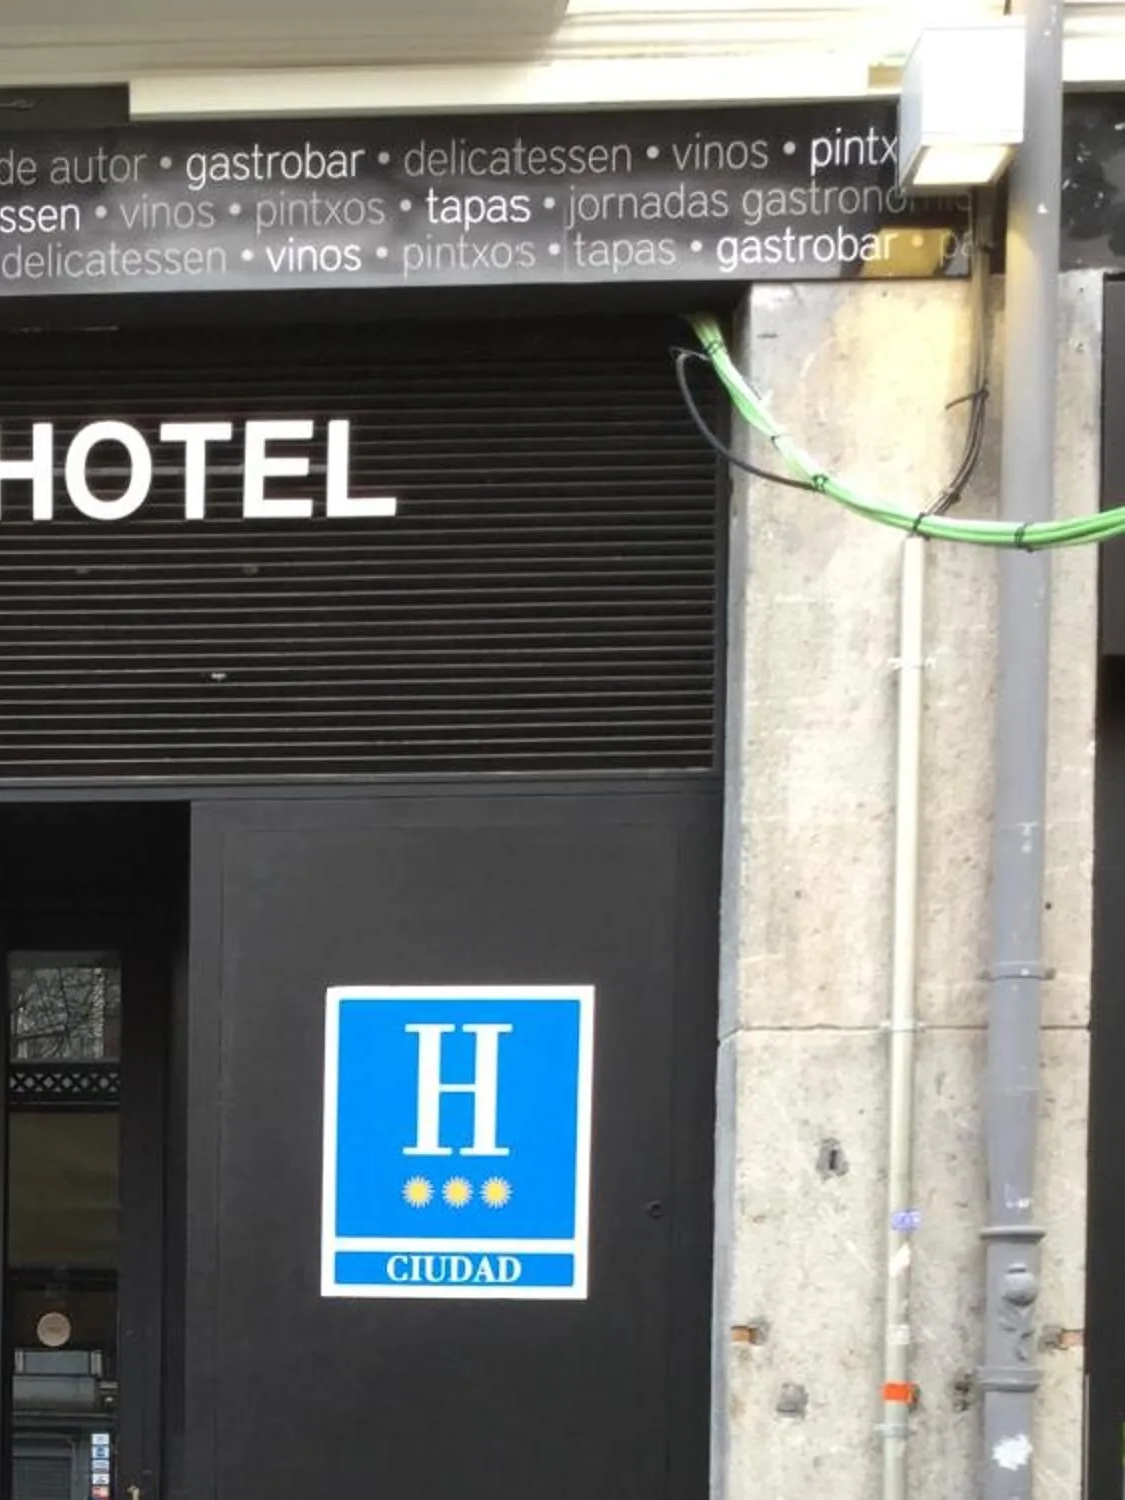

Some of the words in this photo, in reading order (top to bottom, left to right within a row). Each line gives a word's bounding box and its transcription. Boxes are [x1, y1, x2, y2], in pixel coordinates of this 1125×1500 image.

[50, 147, 147, 184] autor
[186, 141, 366, 191] gastrobar
[404, 137, 632, 177] delicatessen
[672, 132, 769, 171] vinos
[810, 127, 898, 177] pintx
[120, 193, 215, 229] vinos
[256, 190, 386, 236] pintxos
[426, 187, 531, 232] tapas
[565, 183, 730, 230] jornadas
[2, 240, 227, 279] delicatessen
[266, 236, 362, 273] vinos
[403, 232, 537, 285] pintxos
[573, 232, 677, 274] tapas
[716, 225, 899, 273] gastrobar
[402, 1022, 514, 1157] H
[386, 1255, 523, 1283] CIUDAD
